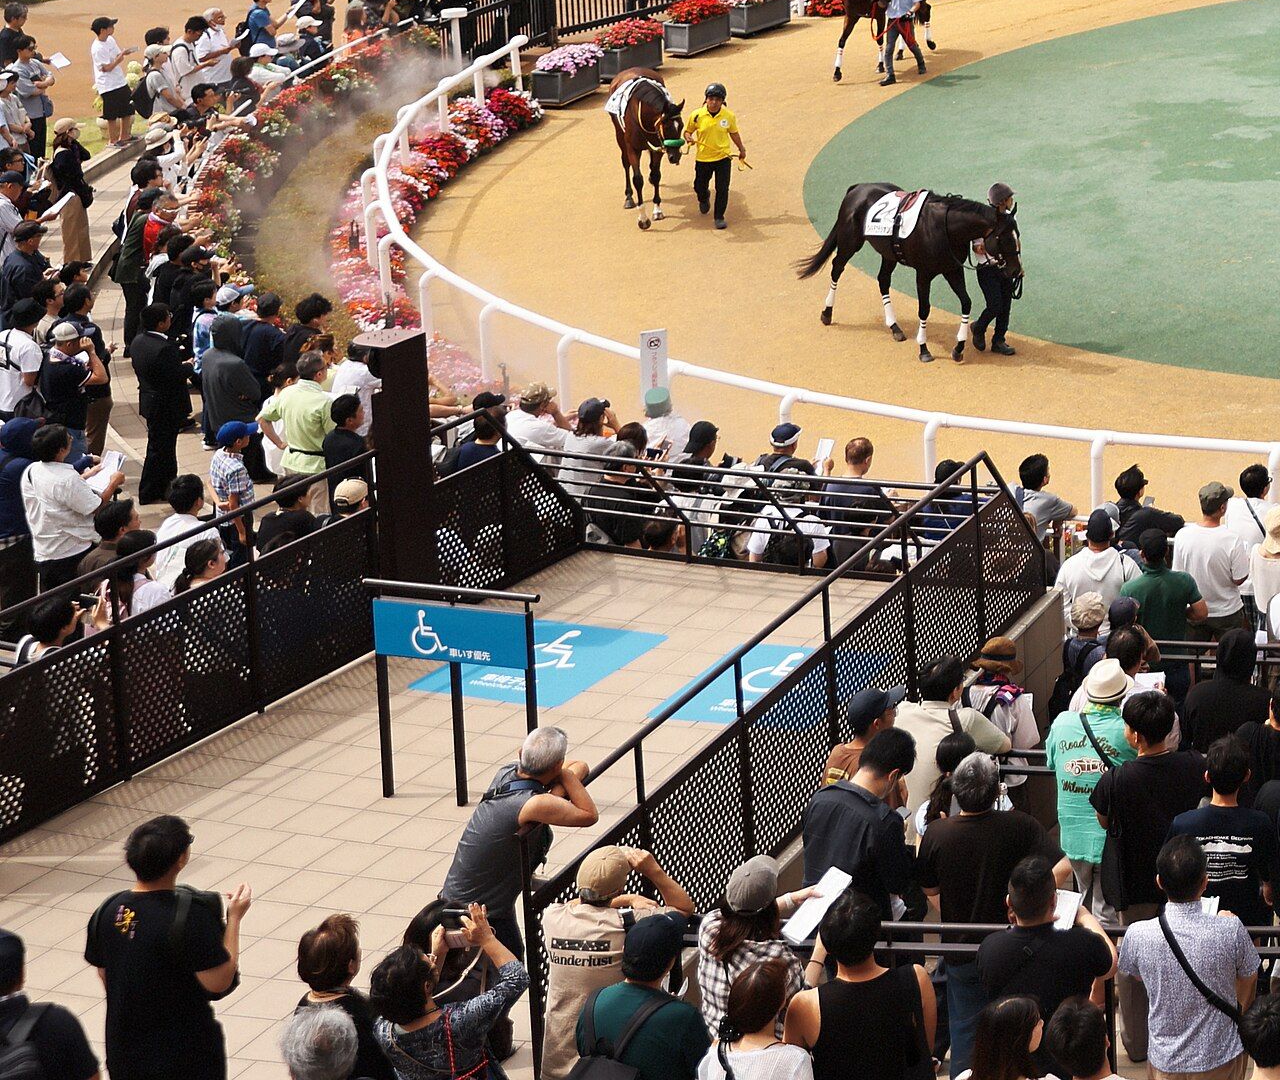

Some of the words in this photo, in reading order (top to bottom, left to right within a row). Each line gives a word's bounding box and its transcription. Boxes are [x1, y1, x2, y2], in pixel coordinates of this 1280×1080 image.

[871, 202, 890, 223] 2
[449, 648, 491, 661] 車いす優先
[1059, 735, 1088, 753] Road
[1061, 779, 1095, 794] Wilmin
